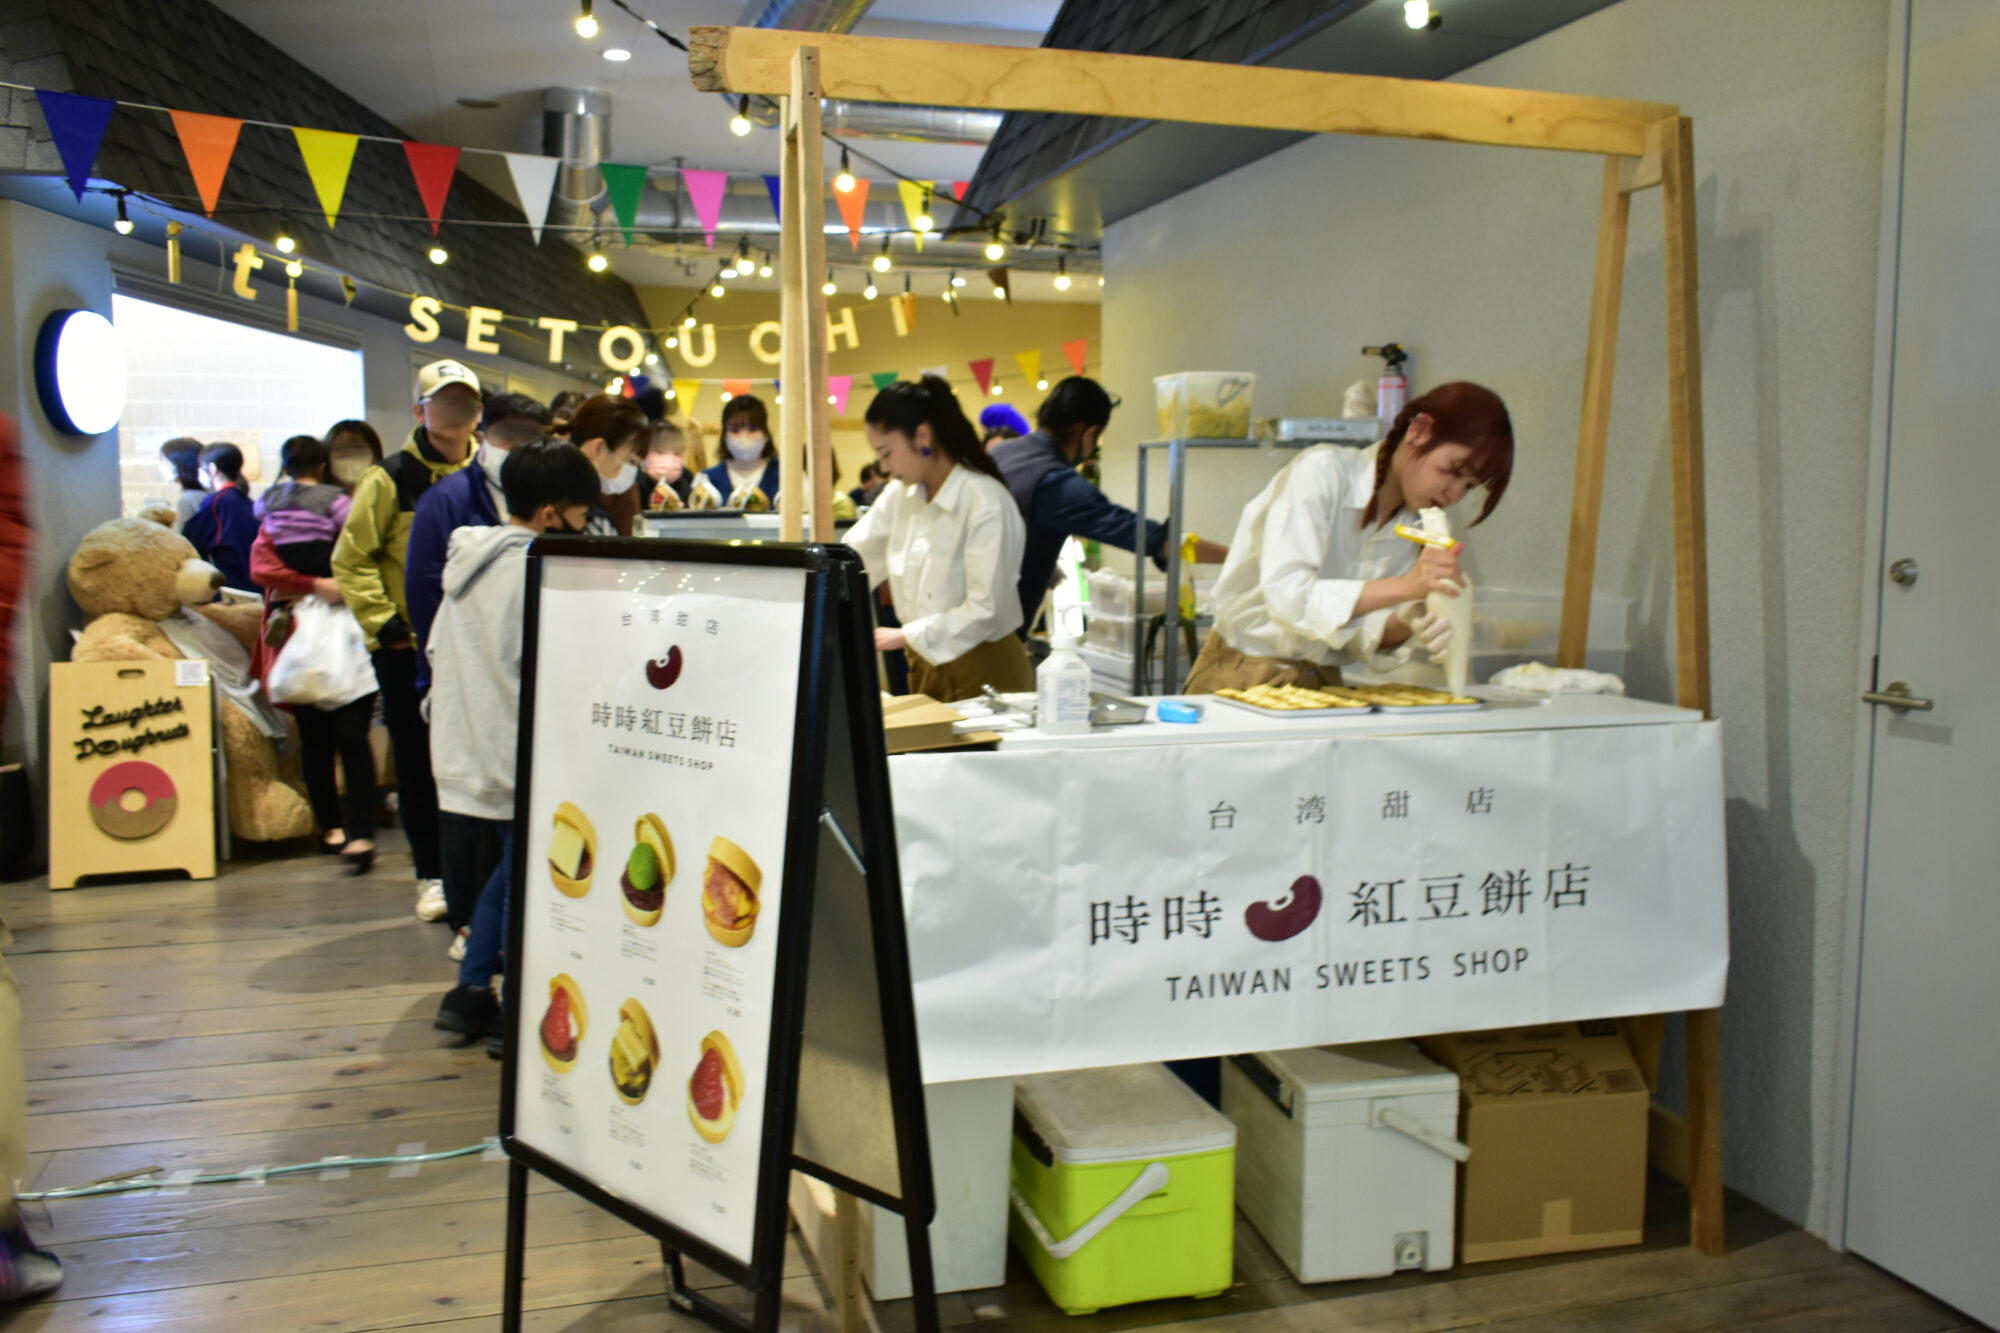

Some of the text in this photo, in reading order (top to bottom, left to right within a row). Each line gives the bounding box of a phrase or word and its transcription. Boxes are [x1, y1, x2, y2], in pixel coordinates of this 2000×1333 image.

[608, 743, 714, 771] TAIWAN SWEETS SHOP
[1166, 947, 1530, 1001] TAIWAN SWEETS SHOP
